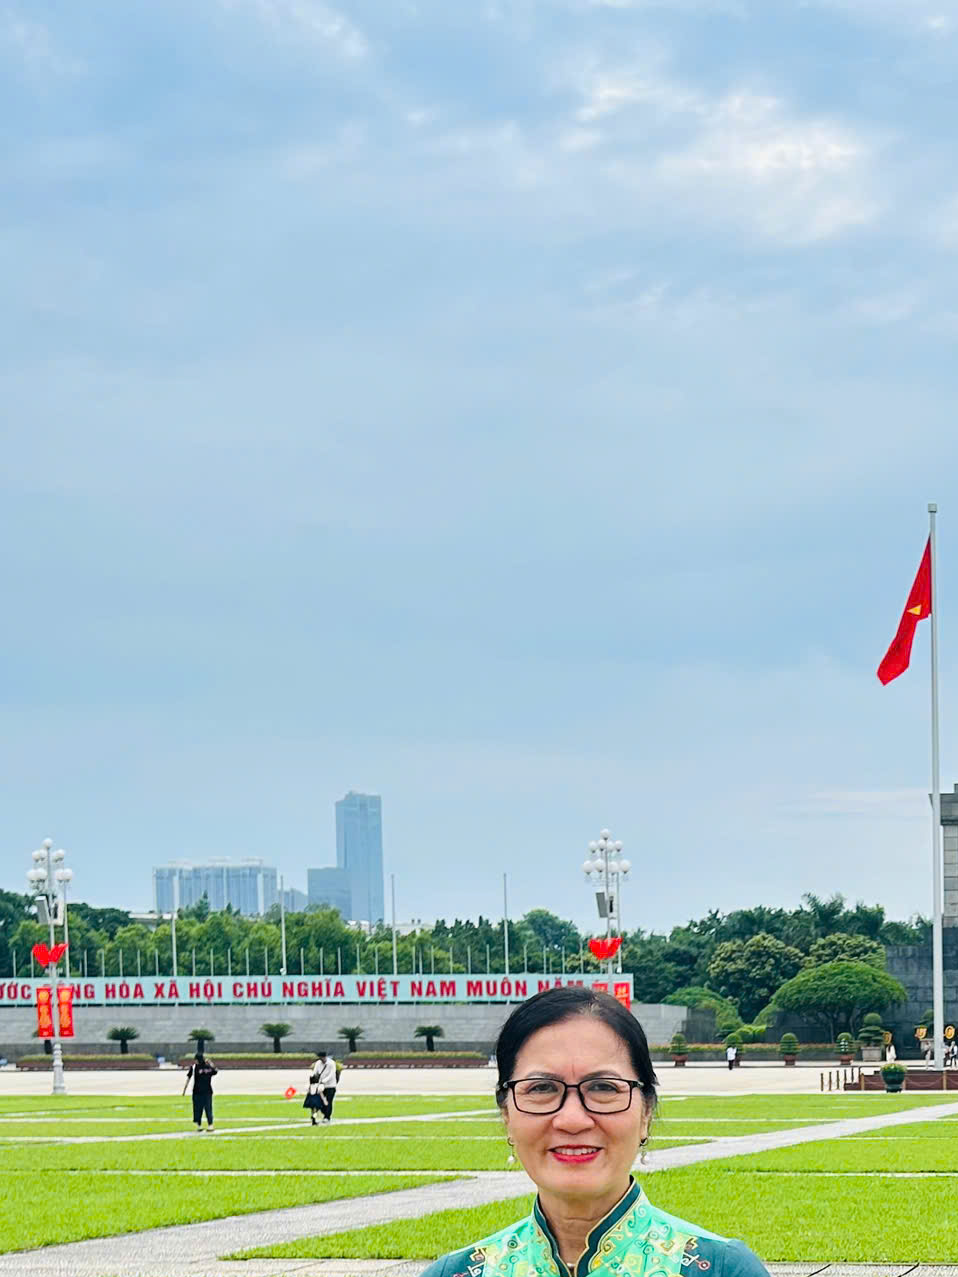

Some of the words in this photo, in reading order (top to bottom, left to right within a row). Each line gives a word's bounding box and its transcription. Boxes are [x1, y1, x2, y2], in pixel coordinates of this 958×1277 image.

[105, 979, 144, 1000] HÒA
[154, 979, 179, 999] XÃ
[189, 979, 222, 1003] HỘI
[232, 976, 272, 998] CHỦ
[282, 978, 345, 998] NGHĨA
[356, 977, 400, 1000] VIỆT
[410, 980, 456, 997] NAM
[466, 976, 527, 997] MUÔN
